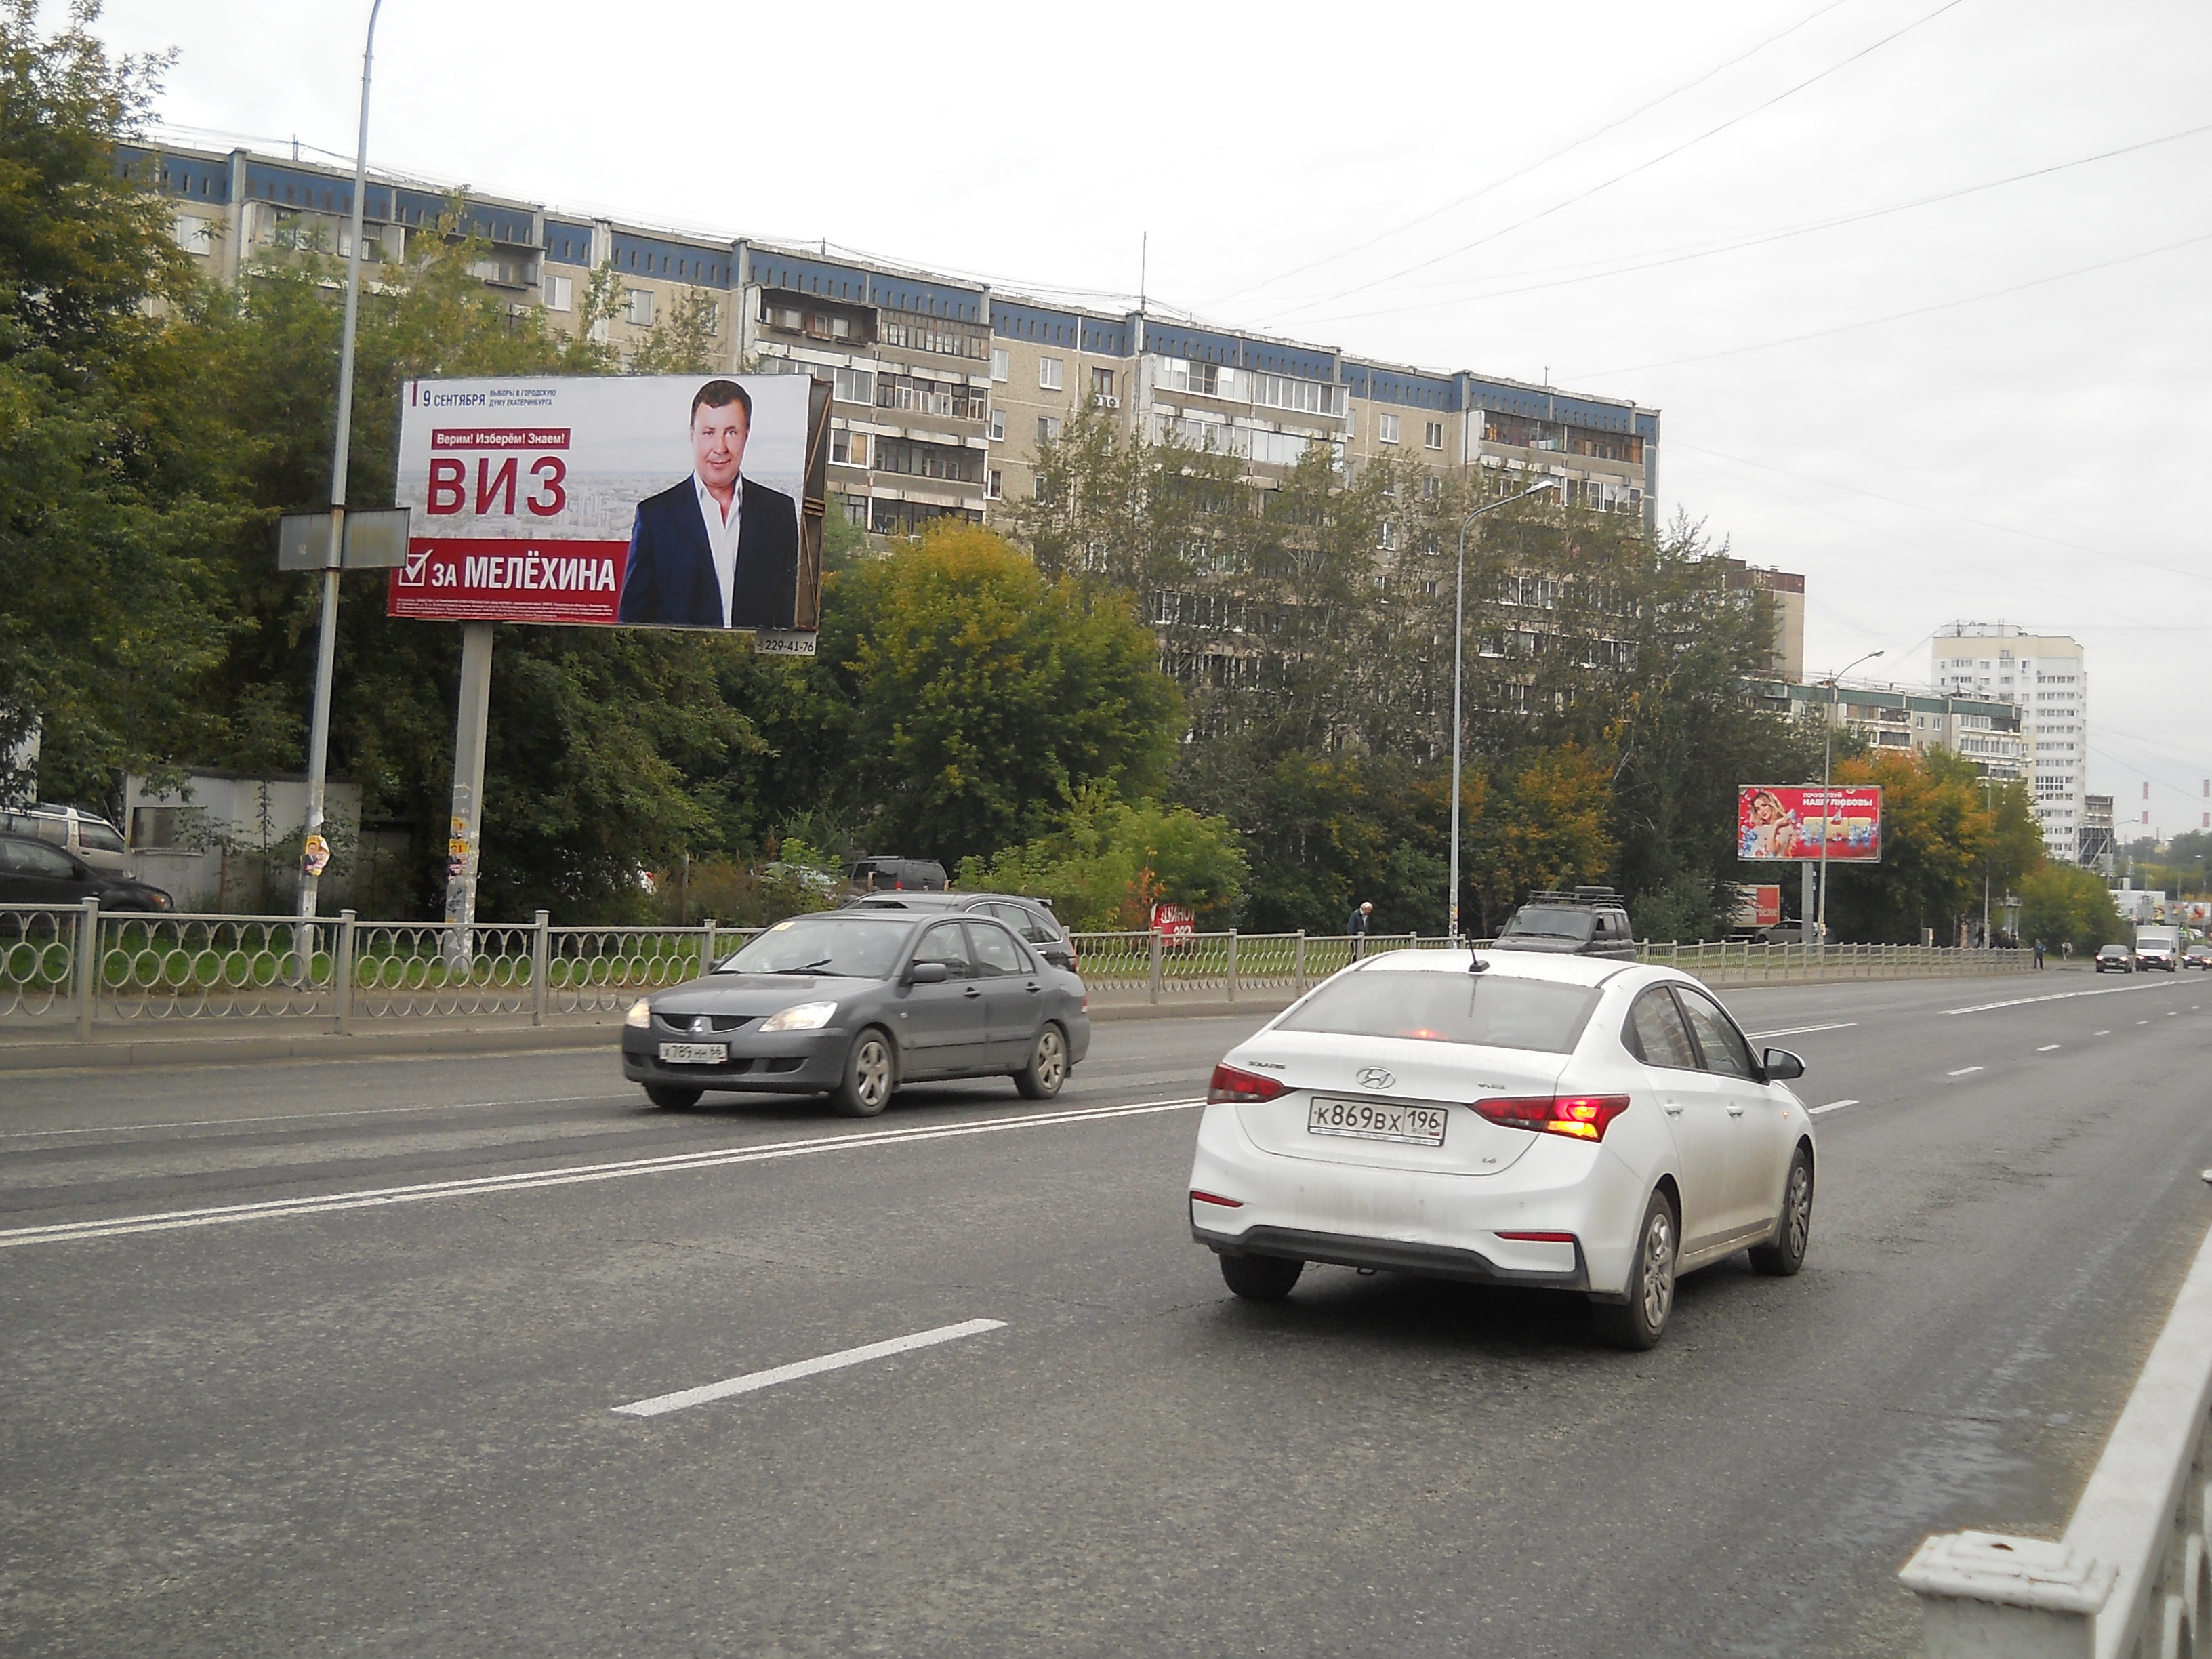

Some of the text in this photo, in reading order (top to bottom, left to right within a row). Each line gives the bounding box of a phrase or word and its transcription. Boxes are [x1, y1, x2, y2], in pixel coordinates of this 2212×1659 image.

[423, 390, 486, 407] 9 СЕНТЯБРЯ
[436, 432, 565, 447] Верим! Изберём! Знаем!
[426, 455, 567, 517] ВИЗ
[431, 550, 616, 592] ЗА МЕЛЁХИНА
[765, 640, 814, 652] 229-41-76
[1317, 1104, 1439, 1132] К869ВХ 196
